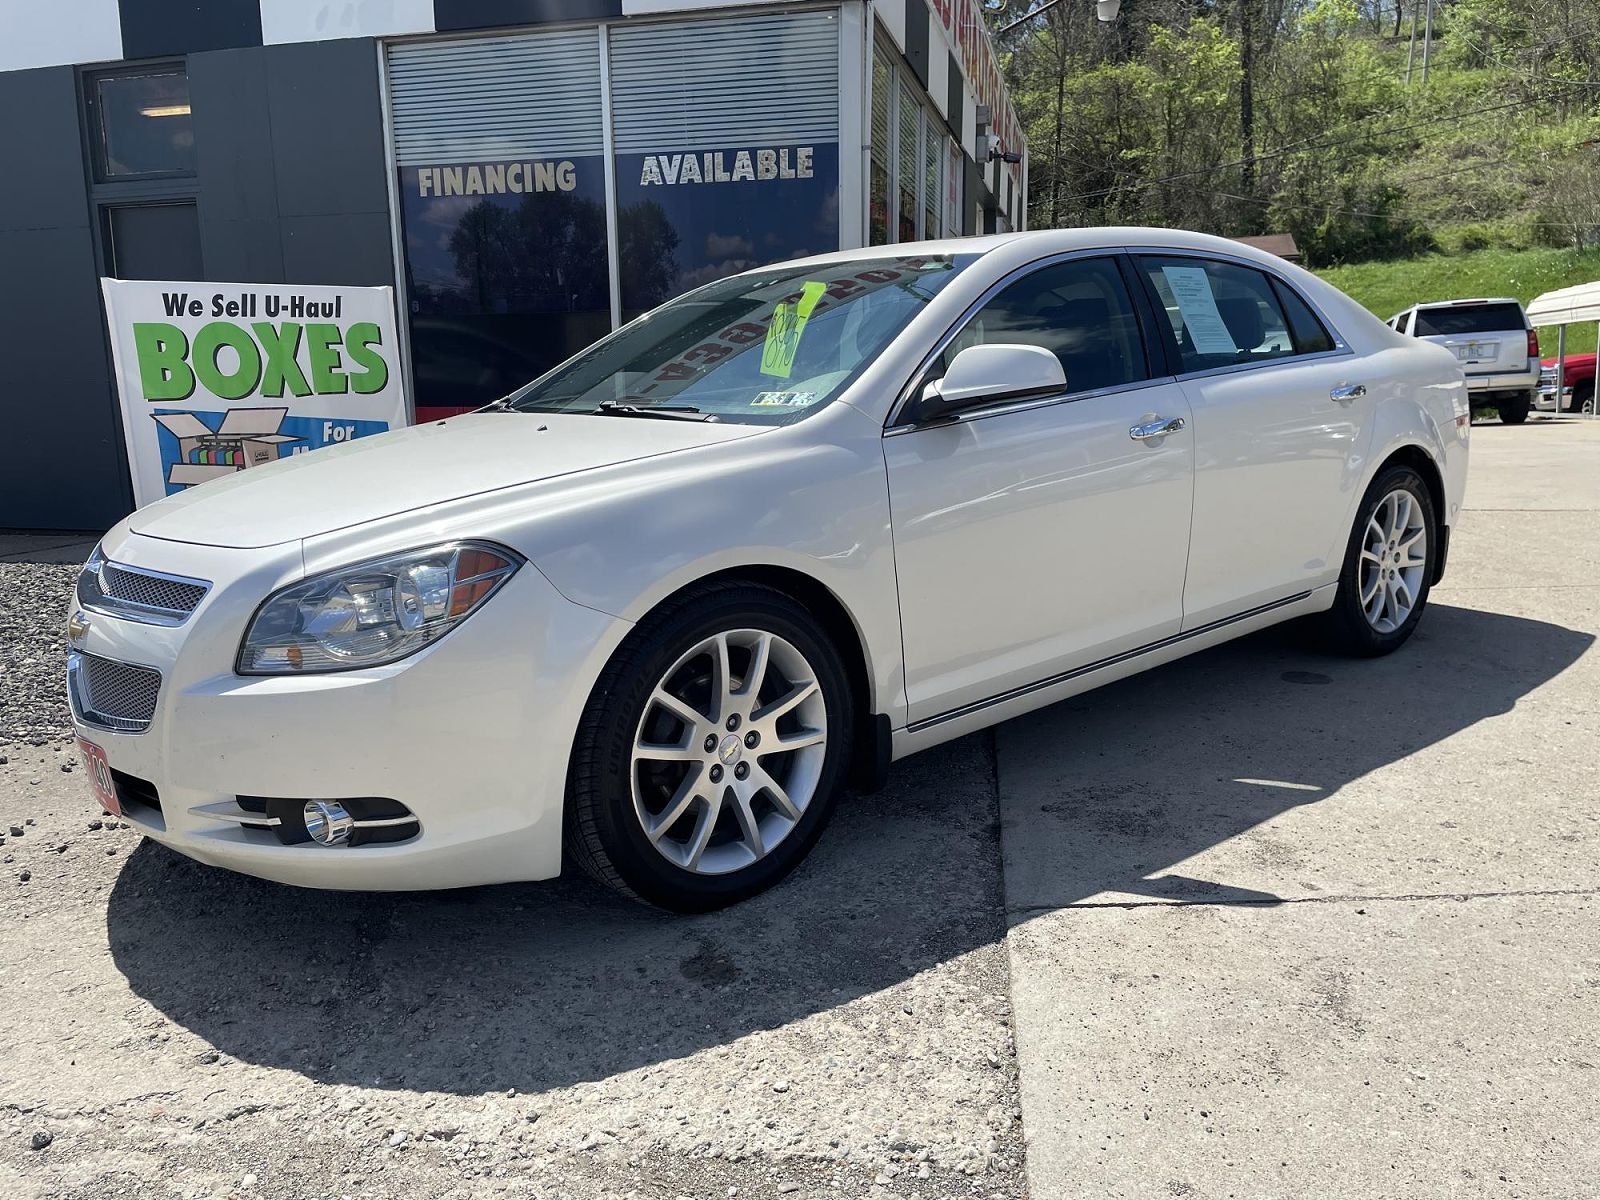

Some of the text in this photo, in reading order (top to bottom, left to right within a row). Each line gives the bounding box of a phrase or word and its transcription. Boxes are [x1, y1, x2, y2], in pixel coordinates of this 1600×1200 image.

[418, 147, 814, 197] FINANCING AVAILABLE
[162, 293, 342, 318] We Sell U-Haul
[133, 321, 389, 401] BOXES
[323, 421, 355, 442] For
